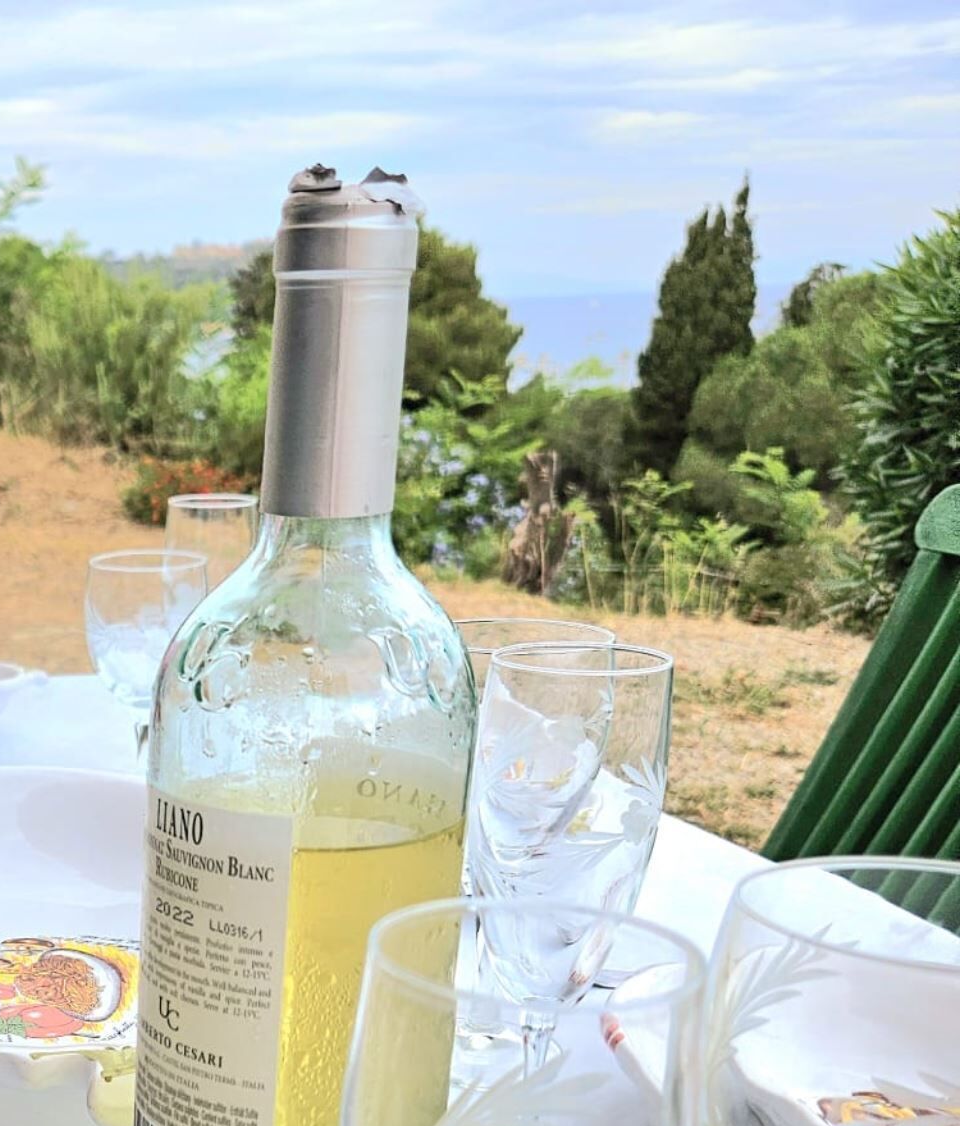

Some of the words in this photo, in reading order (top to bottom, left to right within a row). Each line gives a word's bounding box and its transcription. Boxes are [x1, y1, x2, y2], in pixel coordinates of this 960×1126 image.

[156, 798, 204, 846] LIANO
[155, 854, 199, 893] RUBICONE
[228, 855, 275, 882] BLANC
[155, 897, 194, 927] 2022
[175, 1042, 224, 1069] CESARI
